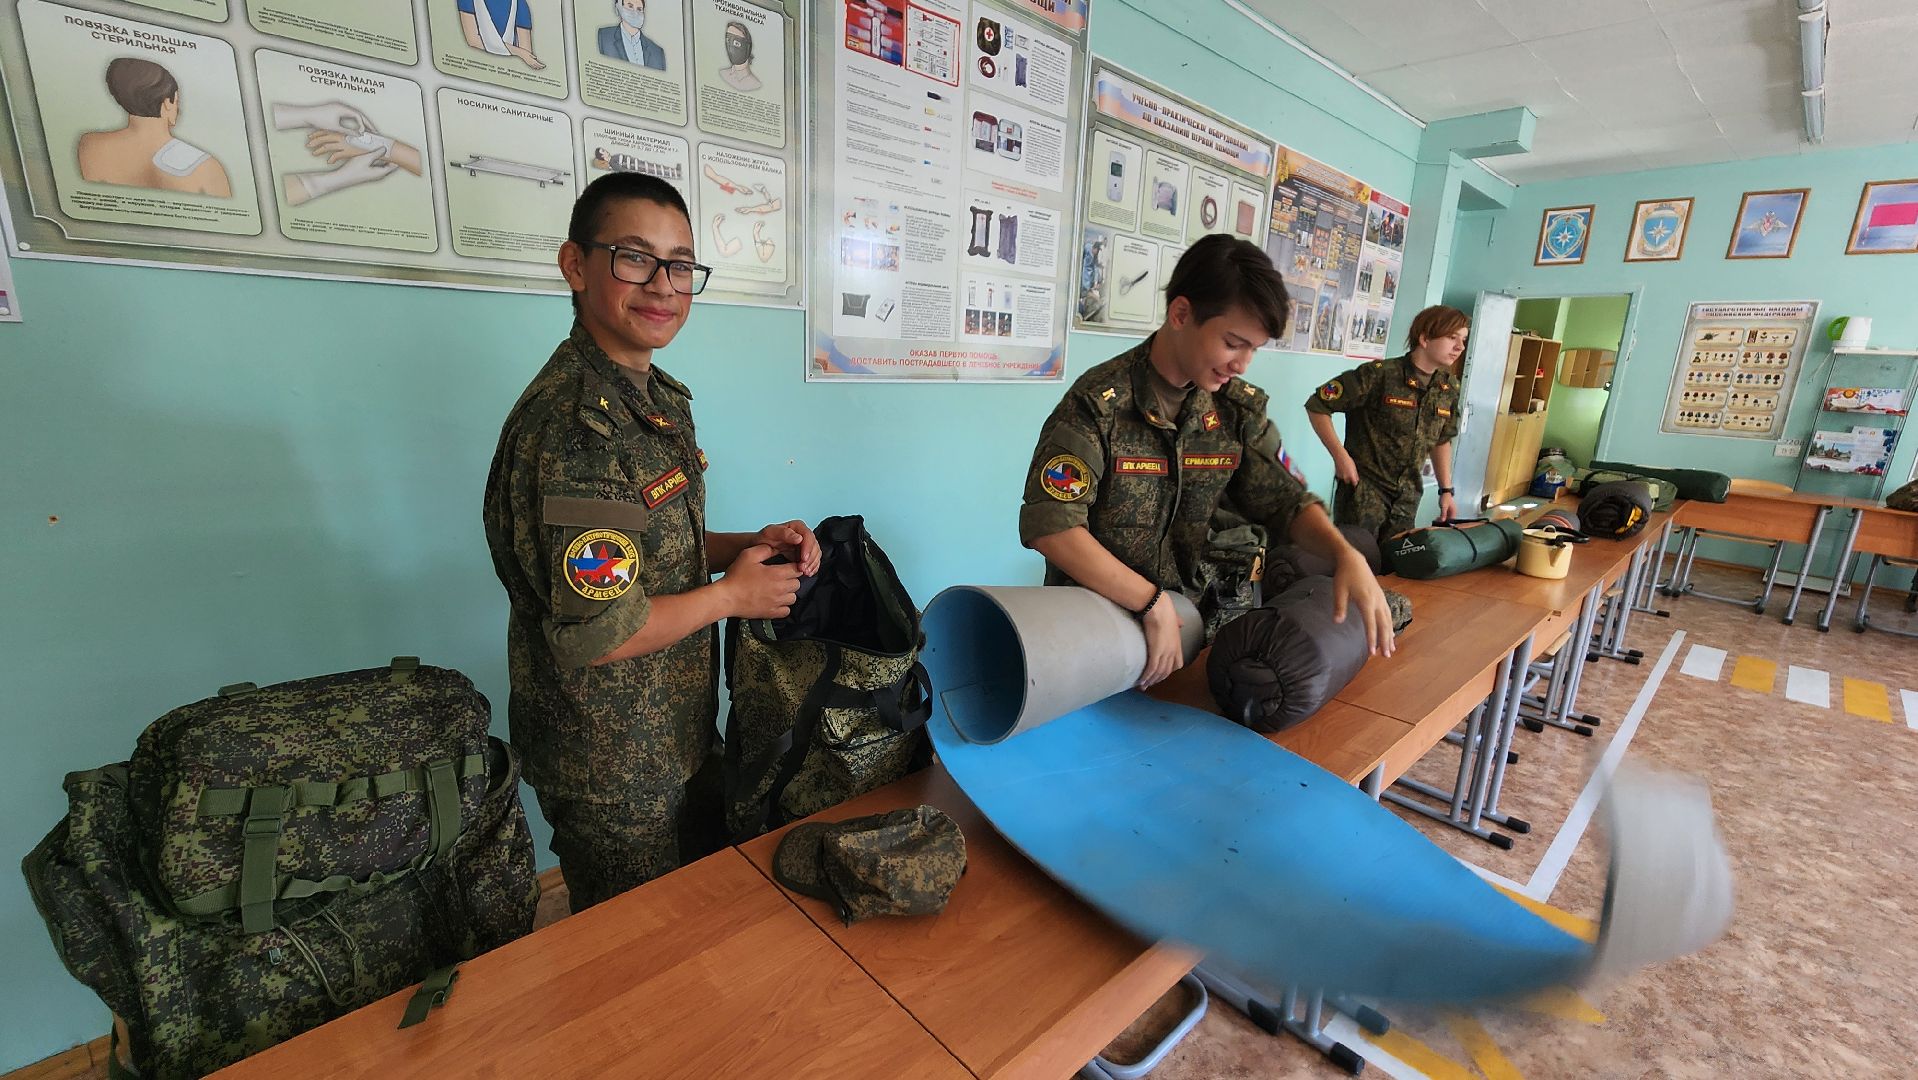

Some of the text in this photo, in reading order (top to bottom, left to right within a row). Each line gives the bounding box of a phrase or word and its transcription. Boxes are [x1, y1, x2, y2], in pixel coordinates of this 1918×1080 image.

[712, 0, 767, 19] РОТИВОПЫЛЬНАЯ
[714, 4, 744, 18] ТКАНЕВАЯ
[64, 15, 197, 49] ПОВЯЗКА БОЛЬШАЯ
[91, 31, 177, 54] СТЕРИЛЬНАЯ
[298, 64, 385, 88] ПОВЯЗКА МАЛАЯ
[310, 75, 376, 95] СТЕРИЛЬНАЯ
[457, 97, 554, 123] НОСИЛКИ САНИТАРНЫЕ
[604, 128, 671, 146] ШИННЫЙ МАТЕРИАЛ
[716, 151, 751, 163] НАЛОЖЕНИЕ
[910, 349, 937, 358] ОКАЗАВ
[939, 350, 968, 359] ПЕРВУЮ
[851, 357, 897, 366] ДОСТАВИТЬ
[899, 358, 960, 368] ПОСТРАДАВШЕГО
[1122, 461, 1161, 472] ВПК АРМЕЕЦ
[1184, 457, 1219, 466] ЕРМАКОВ
[650, 484, 666, 500] ВПК
[581, 585, 623, 598] АРМЕЕЦ
